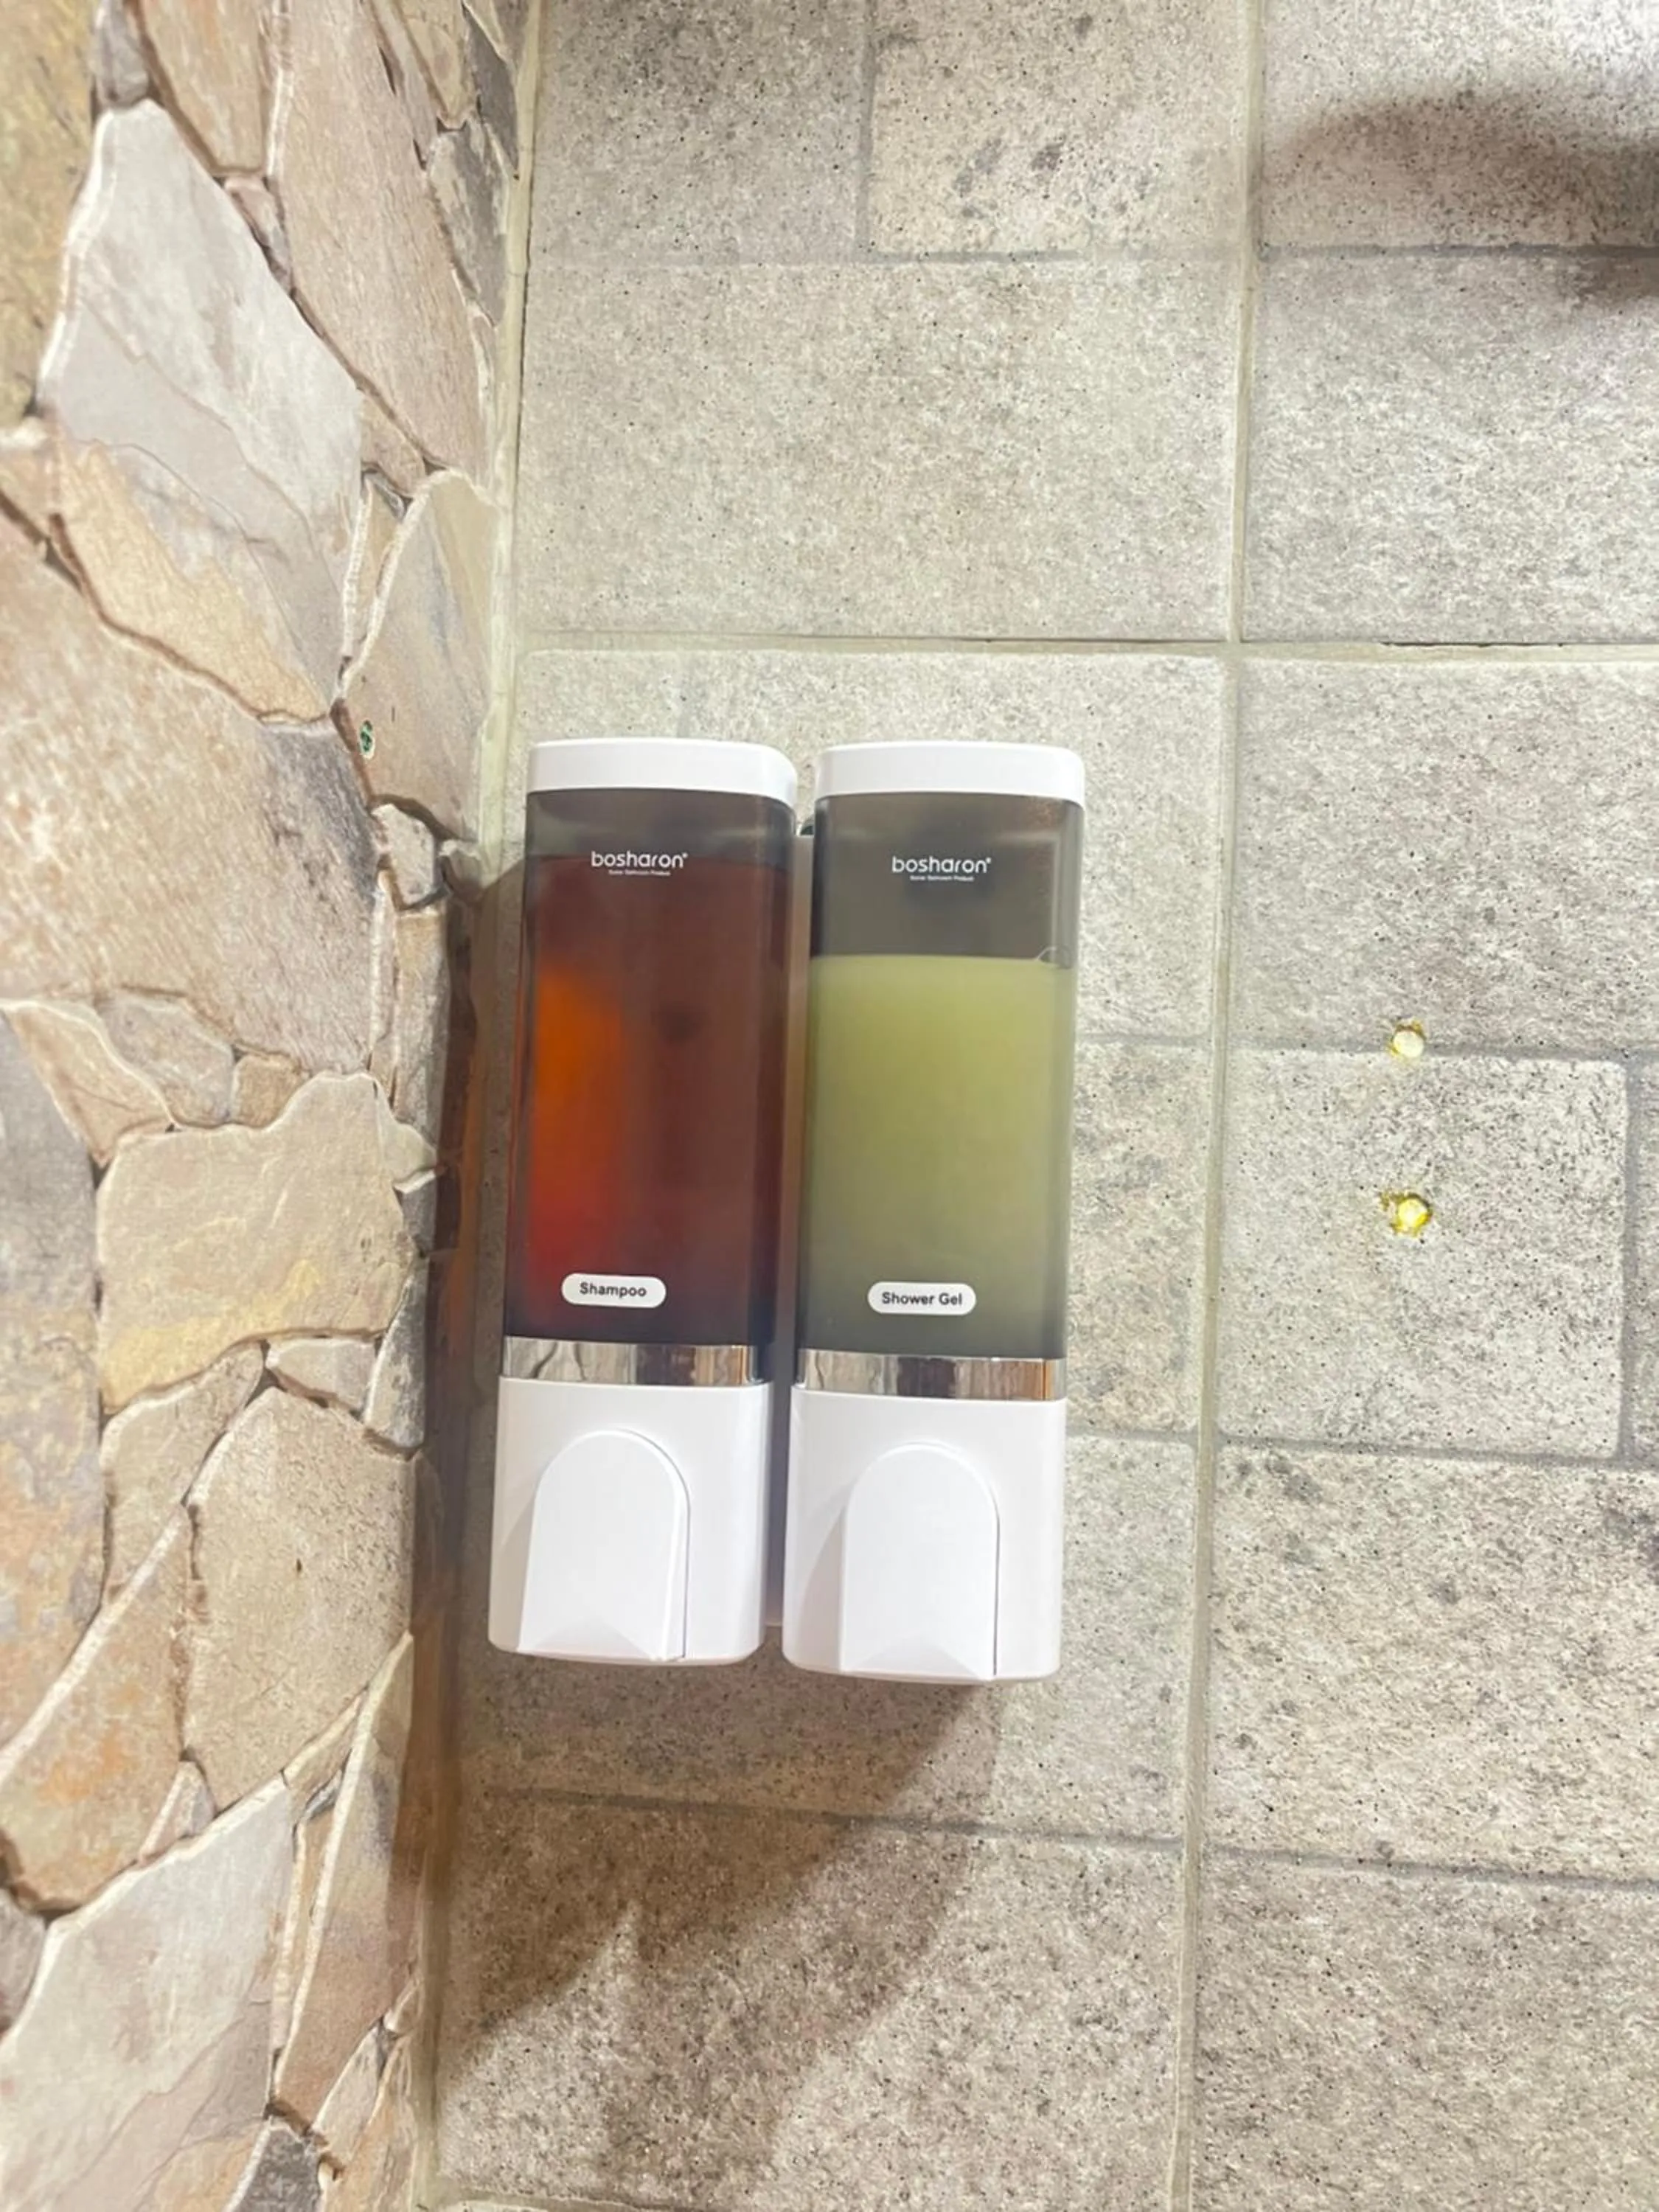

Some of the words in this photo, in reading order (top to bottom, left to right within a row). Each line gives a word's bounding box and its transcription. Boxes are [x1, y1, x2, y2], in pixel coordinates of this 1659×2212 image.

[579, 1281, 647, 1299] Shampoo
[881, 1291, 935, 1305] Shower
[939, 1292, 963, 1306] Gel
